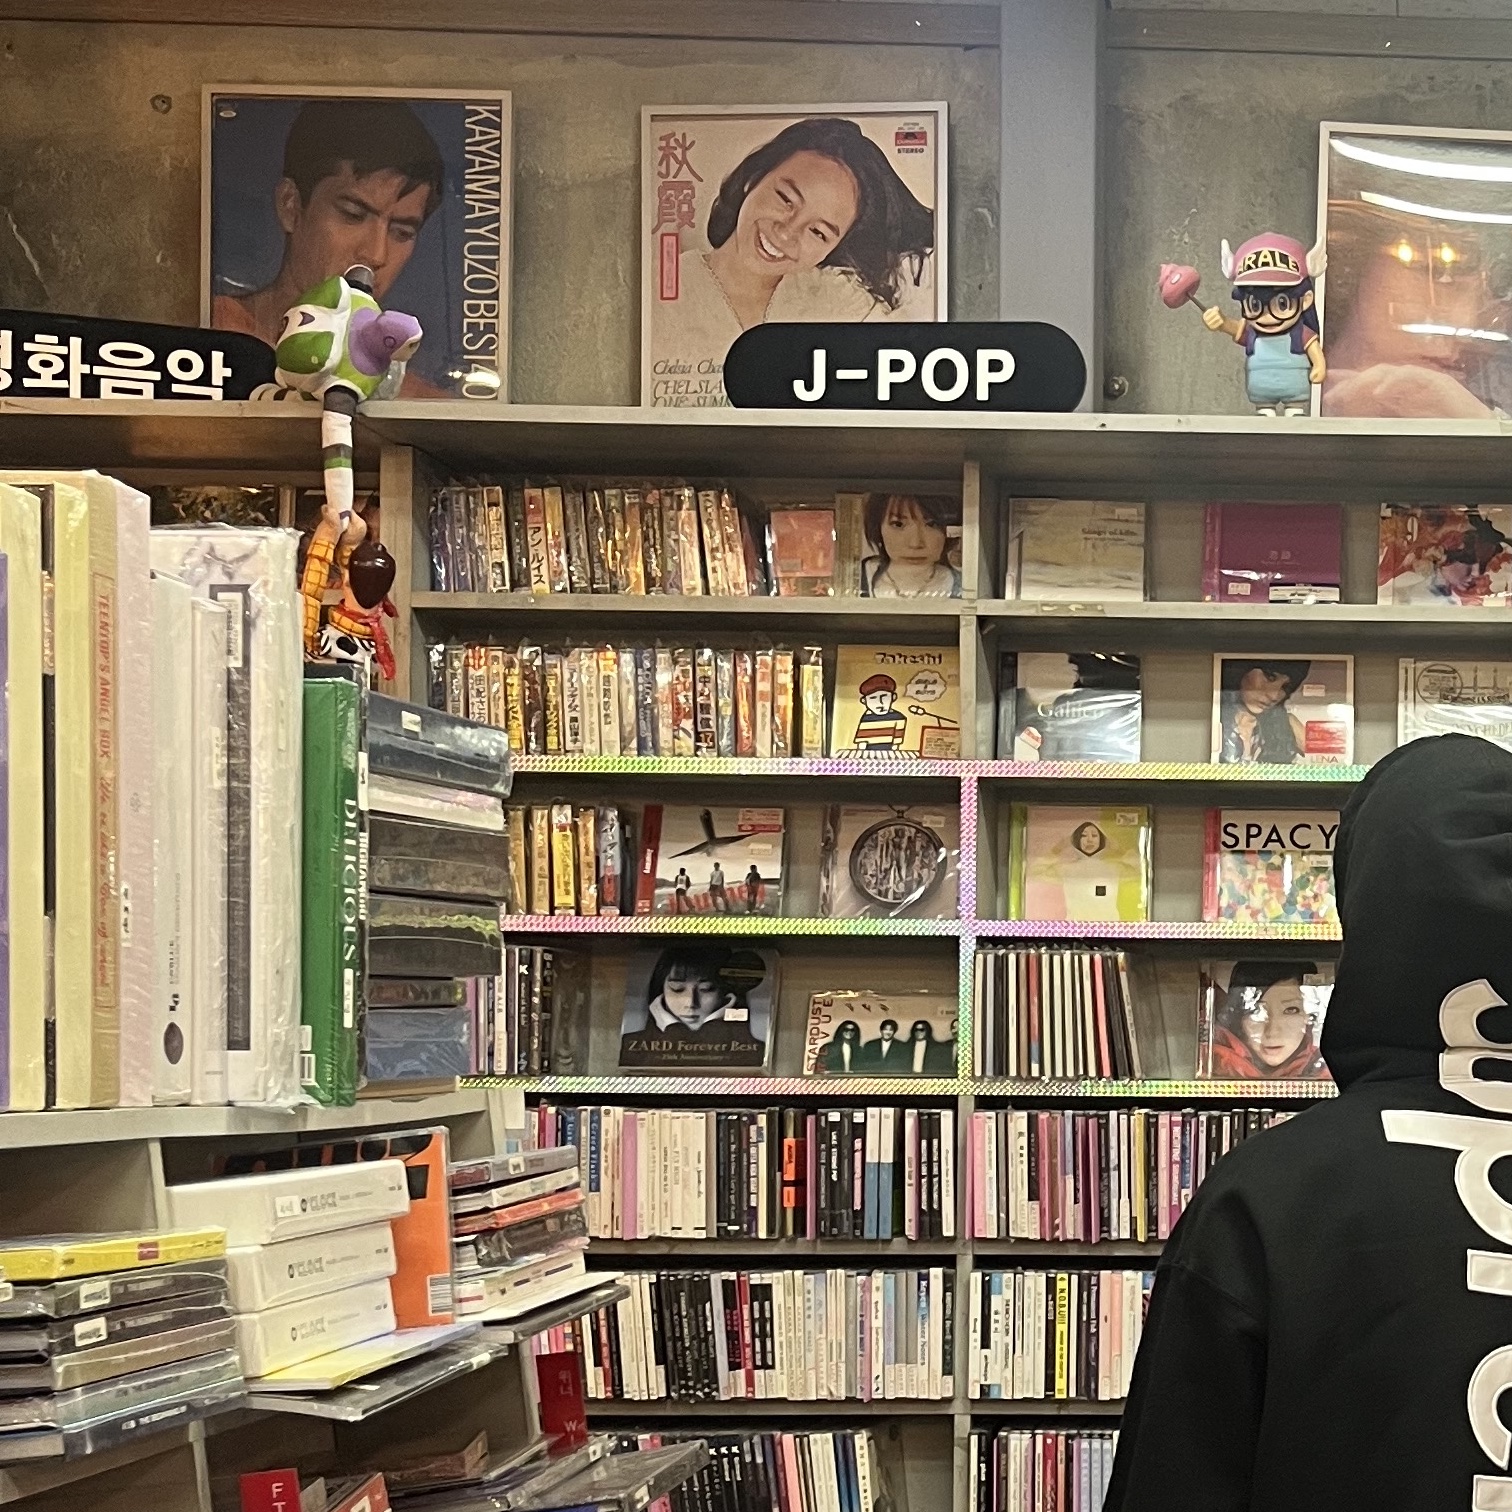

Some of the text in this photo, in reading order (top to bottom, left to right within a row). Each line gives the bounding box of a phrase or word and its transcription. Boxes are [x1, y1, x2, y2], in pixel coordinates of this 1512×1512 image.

[464, 104, 501, 219] KAYAMA
[463, 221, 500, 294] YUZO
[463, 299, 499, 367] BEST
[793, 349, 1016, 402] J-POP
[1220, 822, 1339, 850] SPACY
[342, 798, 358, 962] DELICIOUS
[627, 1040, 759, 1053] ZARD Forever Best
